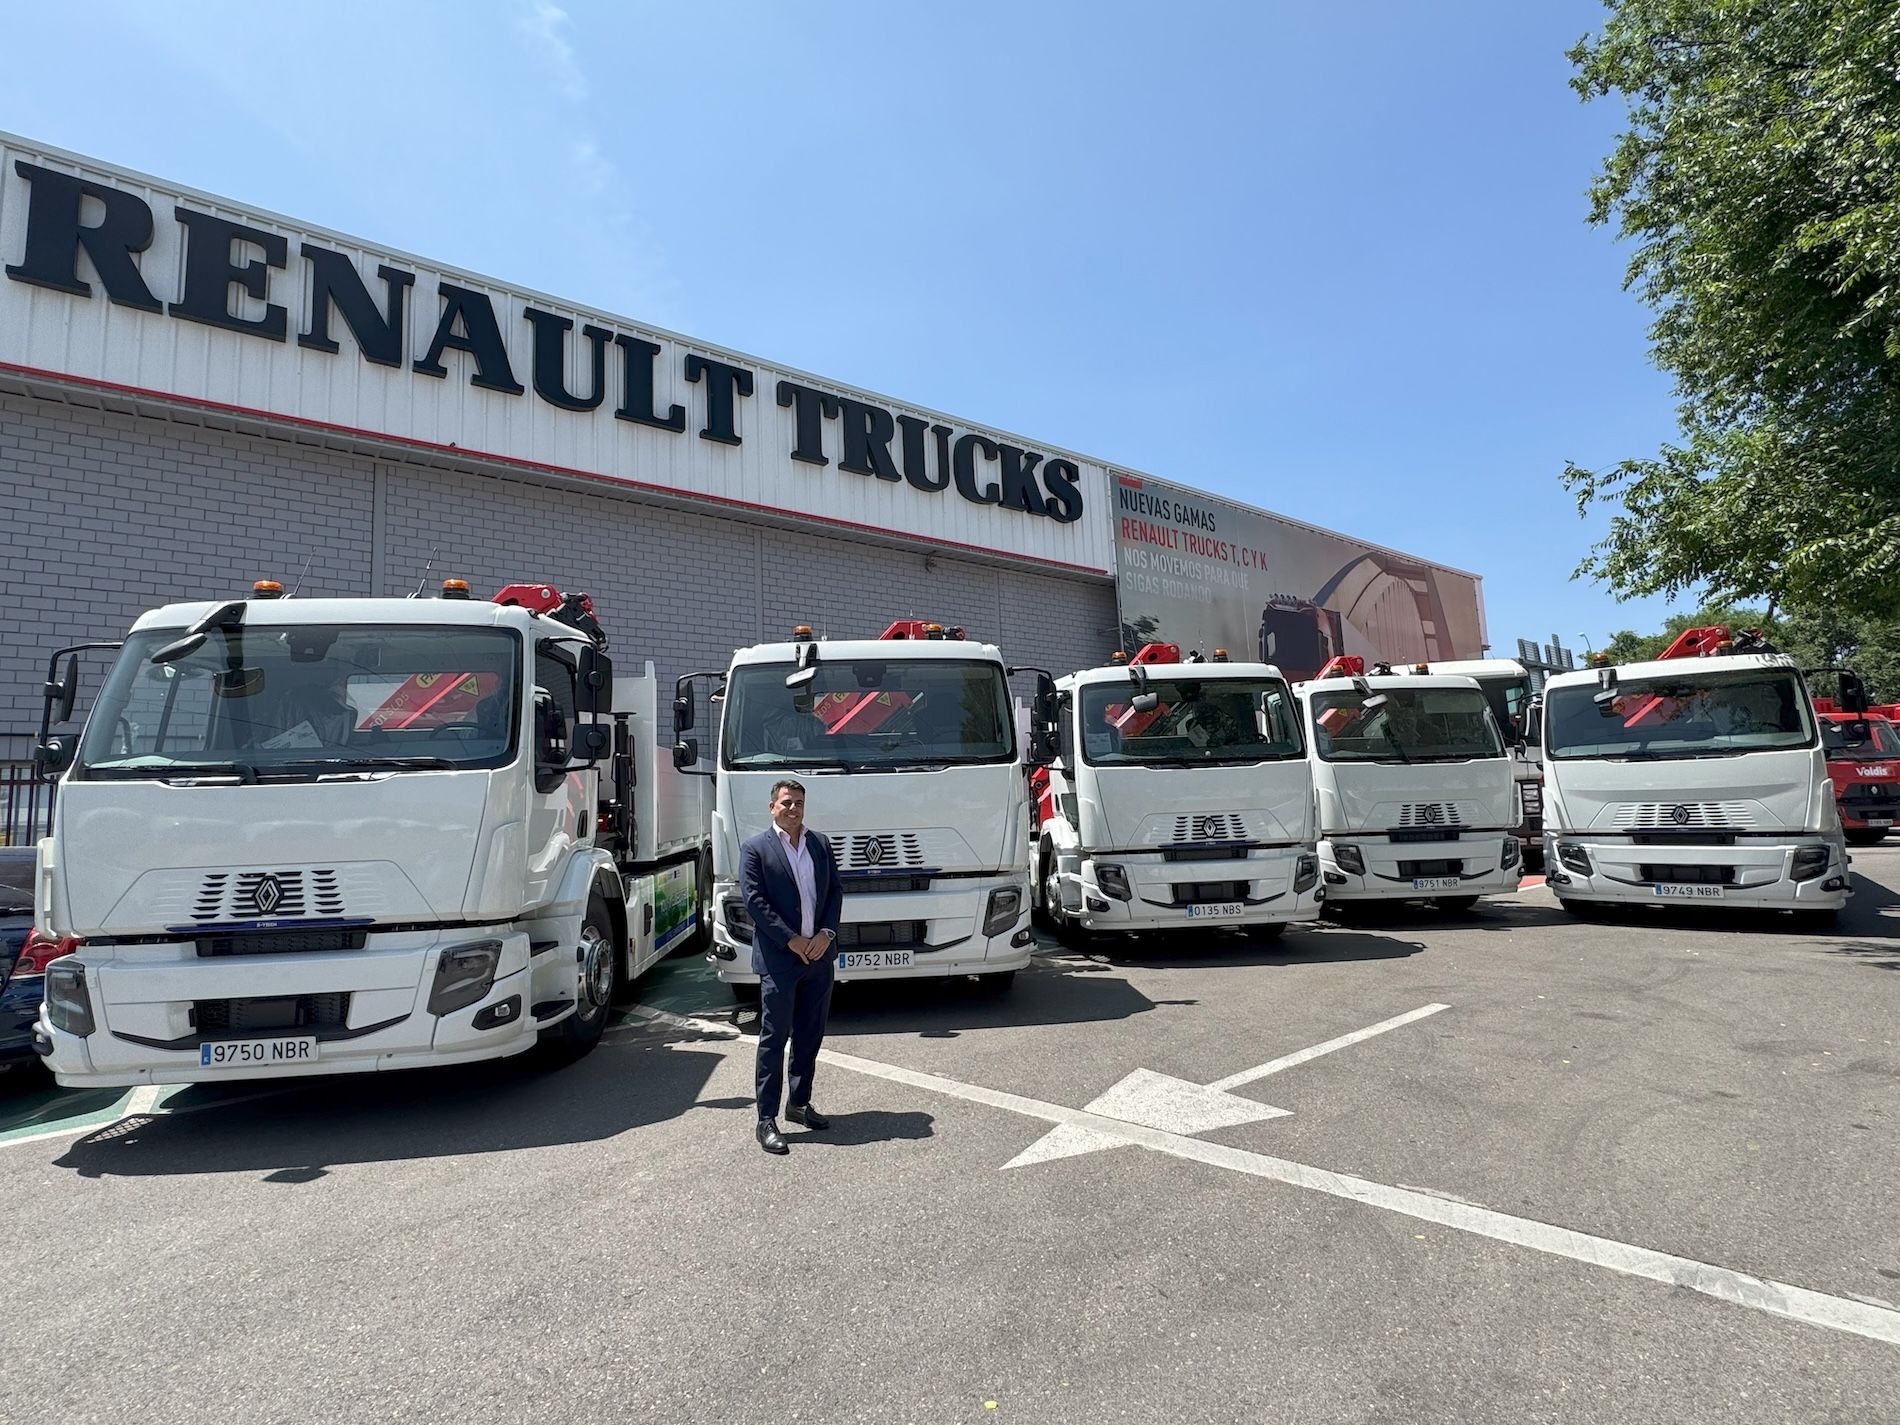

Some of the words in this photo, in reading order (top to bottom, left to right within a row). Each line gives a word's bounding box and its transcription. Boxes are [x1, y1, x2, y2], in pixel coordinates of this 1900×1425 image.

[5, 160, 754, 446] RENAULT
[776, 380, 1083, 524] TRUCKS
[1119, 487, 1171, 520] NUEVAS
[1174, 503, 1216, 532] GAMAS
[1121, 516, 1179, 550] RENAULT
[1182, 531, 1228, 562] TRUCKS
[1242, 547, 1249, 566] C
[1251, 549, 1257, 569] Y
[1260, 552, 1268, 572] K
[1123, 546, 1148, 569] NOS
[1150, 551, 1202, 580] MOVEMOS
[1204, 564, 1230, 585] PARA
[1231, 570, 1249, 591] QUE
[1126, 571, 1159, 595] SIGAS
[1855, 766, 1888, 777] Voldis
[1418, 879, 1439, 889] 9751
[1442, 878, 1458, 887] NBR
[1663, 886, 1693, 895] 9749
[1697, 887, 1720, 896] NBR
[1194, 905, 1220, 916] 0135
[1222, 904, 1242, 915] NBS
[847, 953, 881, 967] 9752
[885, 952, 910, 965] NBR
[213, 1043, 265, 1062] 9750
[272, 1041, 310, 1060] NBR
